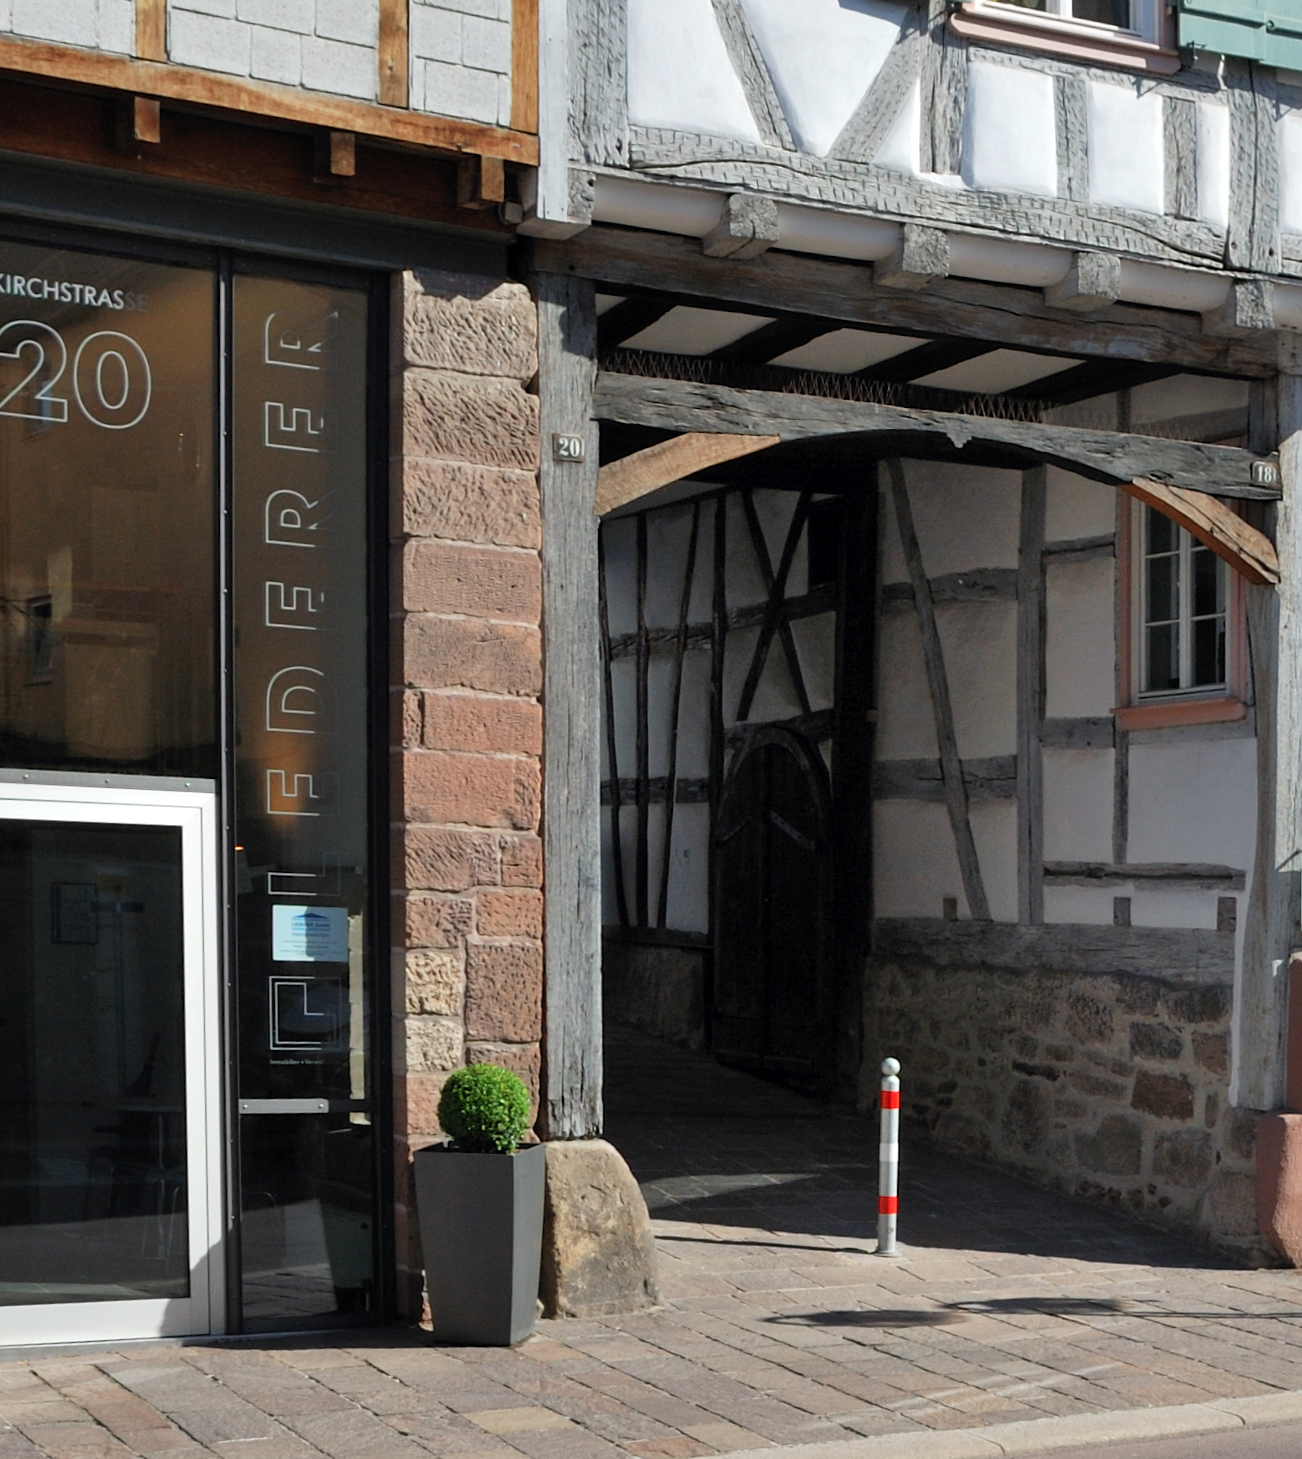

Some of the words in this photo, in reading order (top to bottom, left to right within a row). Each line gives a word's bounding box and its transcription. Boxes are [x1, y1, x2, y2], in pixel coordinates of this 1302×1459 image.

[0, 319, 152, 430] 20
[558, 437, 580, 457] 20
[1257, 465, 1272, 483] 18
[264, 310, 342, 896] LEDERER
